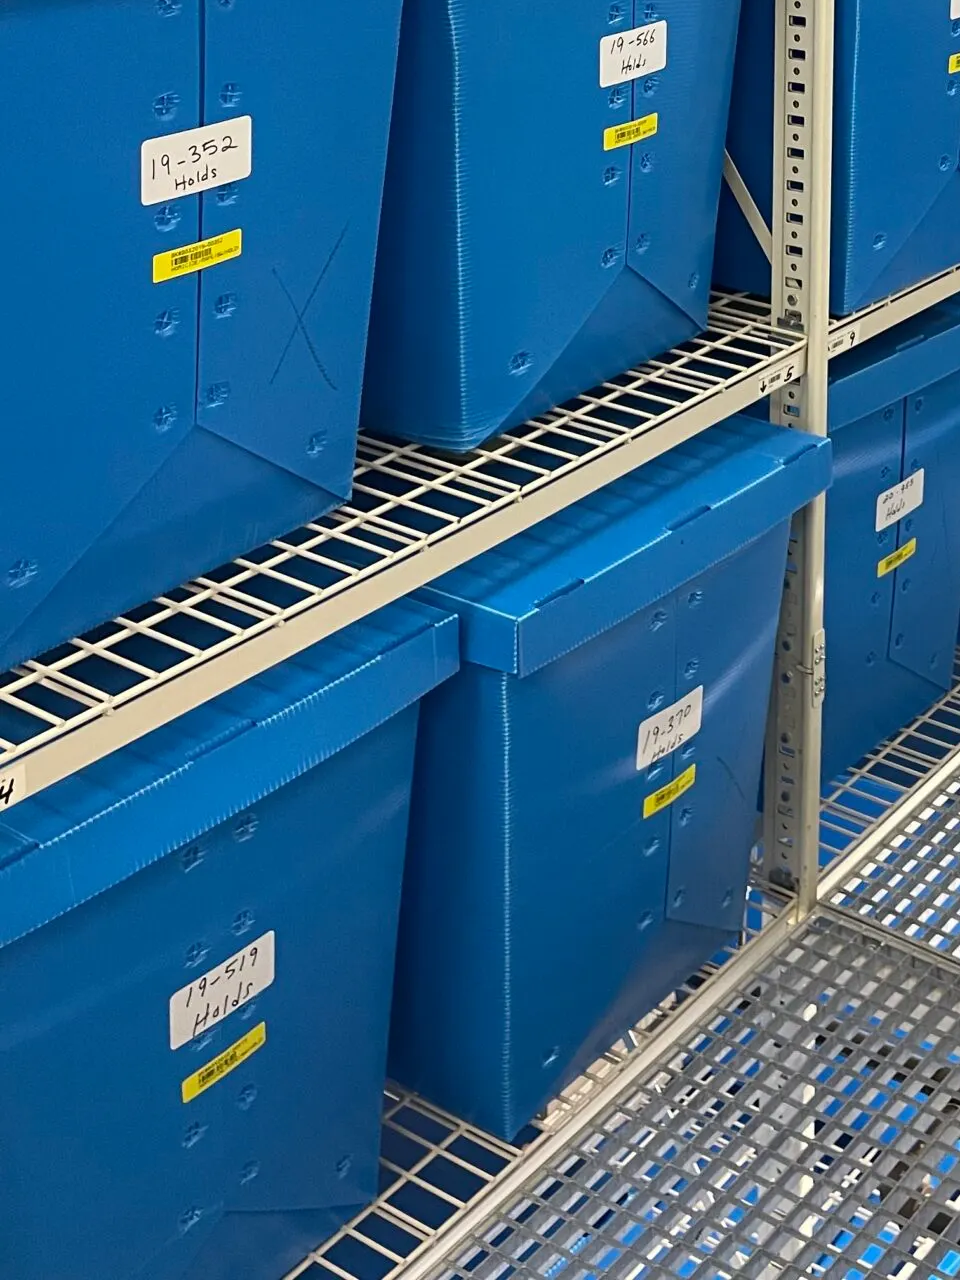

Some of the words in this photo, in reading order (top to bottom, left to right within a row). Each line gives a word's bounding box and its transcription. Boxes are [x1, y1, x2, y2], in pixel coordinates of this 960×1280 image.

[610, 28, 656, 55] 19-566
[620, 54, 647, 75] Holds
[151, 135, 239, 180] 19-352
[174, 163, 217, 191] Holds
[849, 330, 856, 347] 9
[783, 365, 794, 383] 5
[642, 704, 692, 756] 19-370
[186, 947, 258, 1008] 19-519
[192, 981, 253, 1038] Holds
